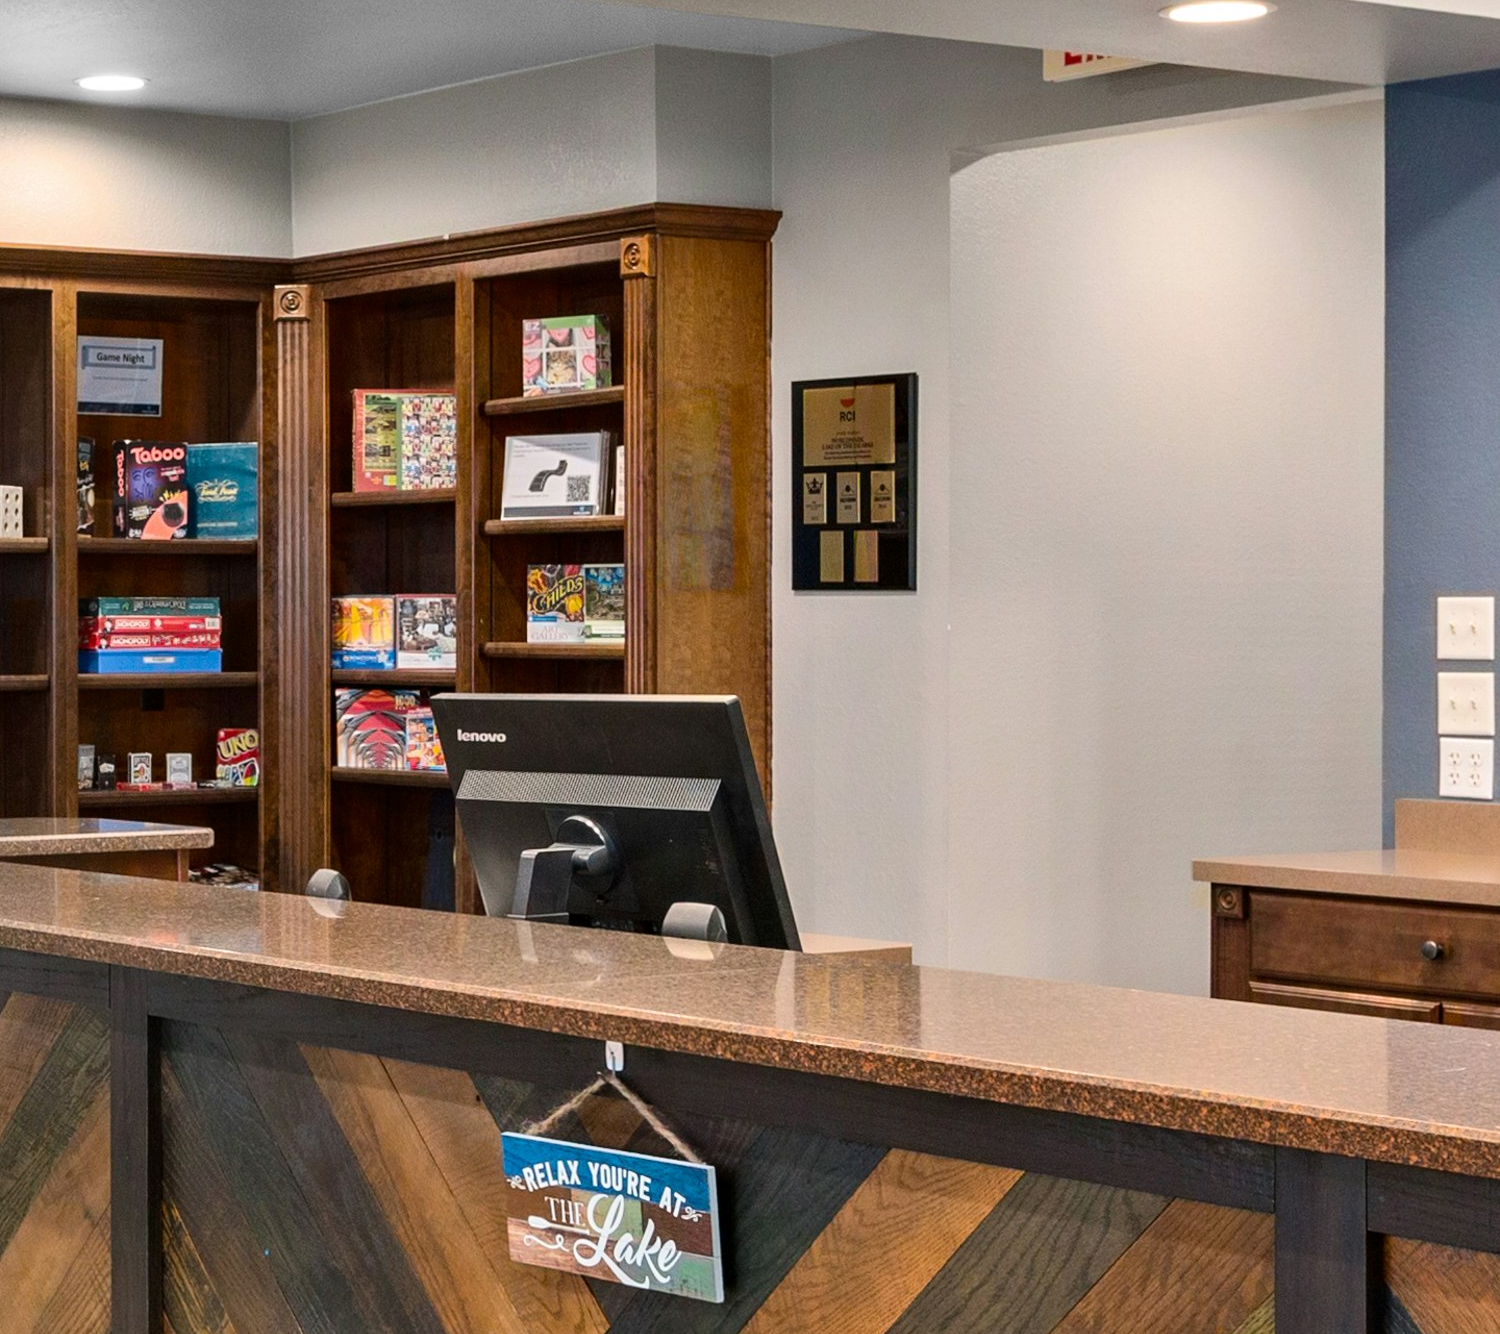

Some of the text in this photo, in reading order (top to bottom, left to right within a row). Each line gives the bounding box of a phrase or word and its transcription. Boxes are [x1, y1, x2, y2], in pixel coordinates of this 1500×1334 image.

[96, 352, 145, 364] Game Night
[839, 411, 856, 422] RCI
[130, 446, 185, 465] Taboo
[116, 450, 125, 497] Taboo
[218, 730, 259, 761] UNO
[456, 729, 507, 743] lenovo
[521, 1160, 687, 1218] RELAX YOU'RE AT
[544, 1195, 586, 1228] THE
[572, 1193, 683, 1290] Lake
